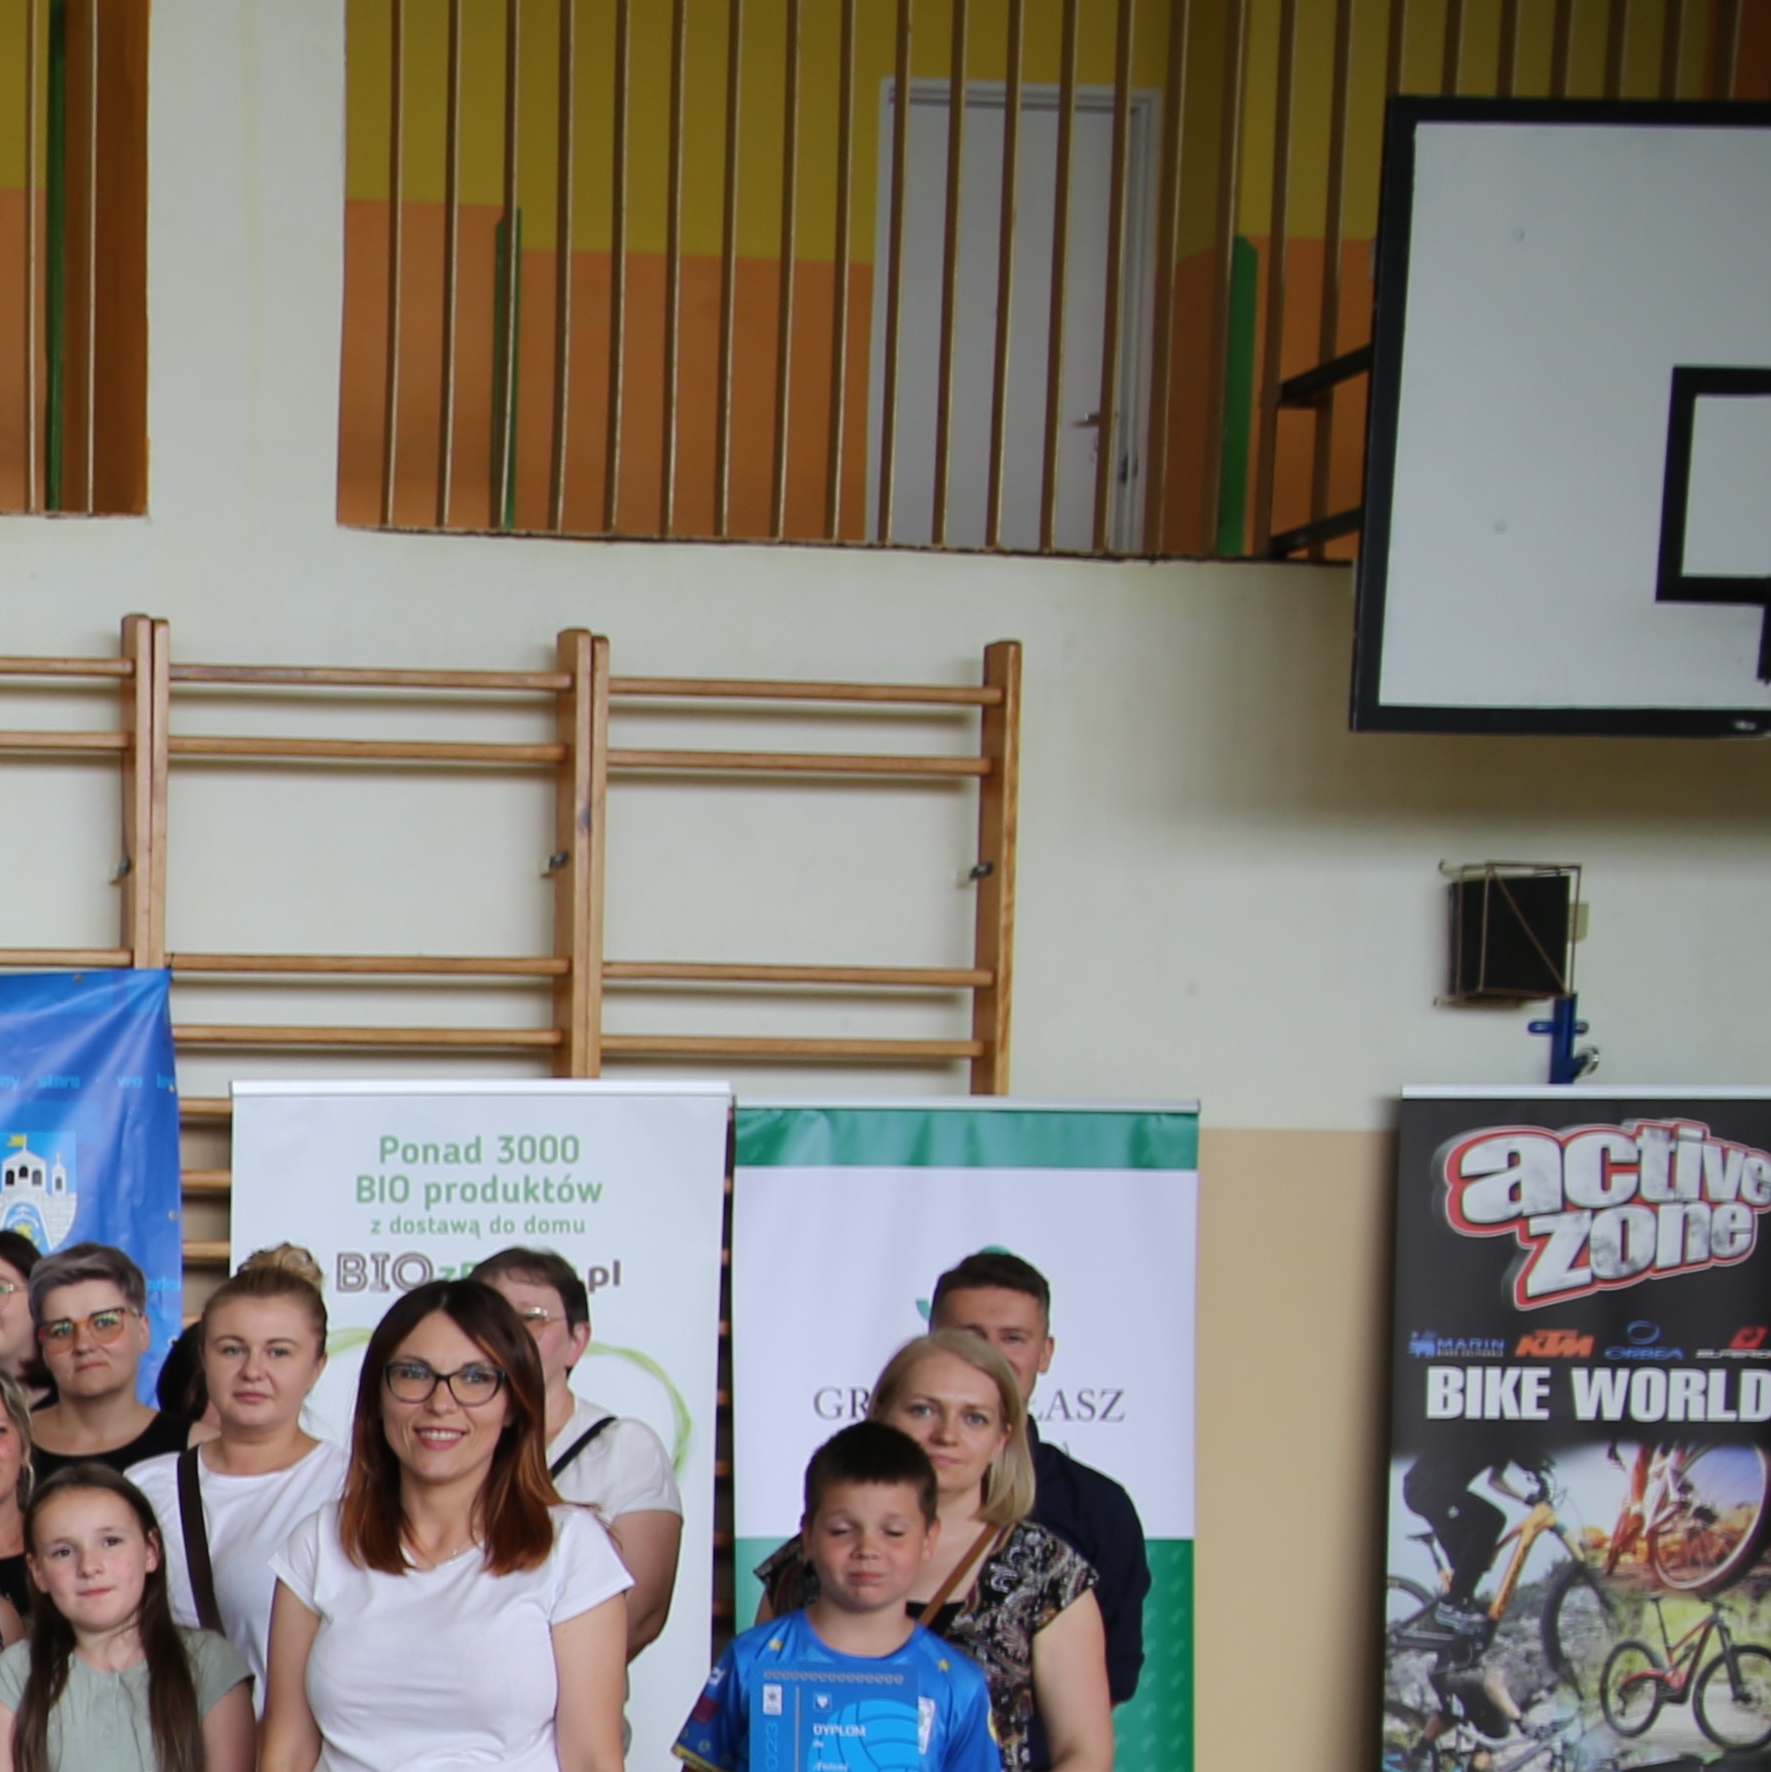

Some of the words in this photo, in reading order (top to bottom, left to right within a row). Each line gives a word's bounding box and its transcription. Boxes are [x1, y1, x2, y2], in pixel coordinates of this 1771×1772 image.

[378, 1134, 483, 1166] Ponad
[497, 1134, 581, 1166] 3000
[1459, 1125, 1771, 1226] active
[355, 1175, 410, 1204] BIO
[423, 1173, 604, 1211] produktów
[370, 1220, 383, 1235] z
[391, 1214, 482, 1240] dostawą
[488, 1214, 517, 1236] do
[523, 1214, 587, 1236] domu
[1525, 1201, 1754, 1299] zone
[1437, 1338, 1504, 1350] MARIN
[1515, 1329, 1596, 1359] KTM
[1604, 1346, 1685, 1361] ORBEA
[1425, 1365, 1551, 1421] BIKE
[1570, 1367, 1771, 1423] WORLD
[812, 1722, 866, 1738] DYPLOM
